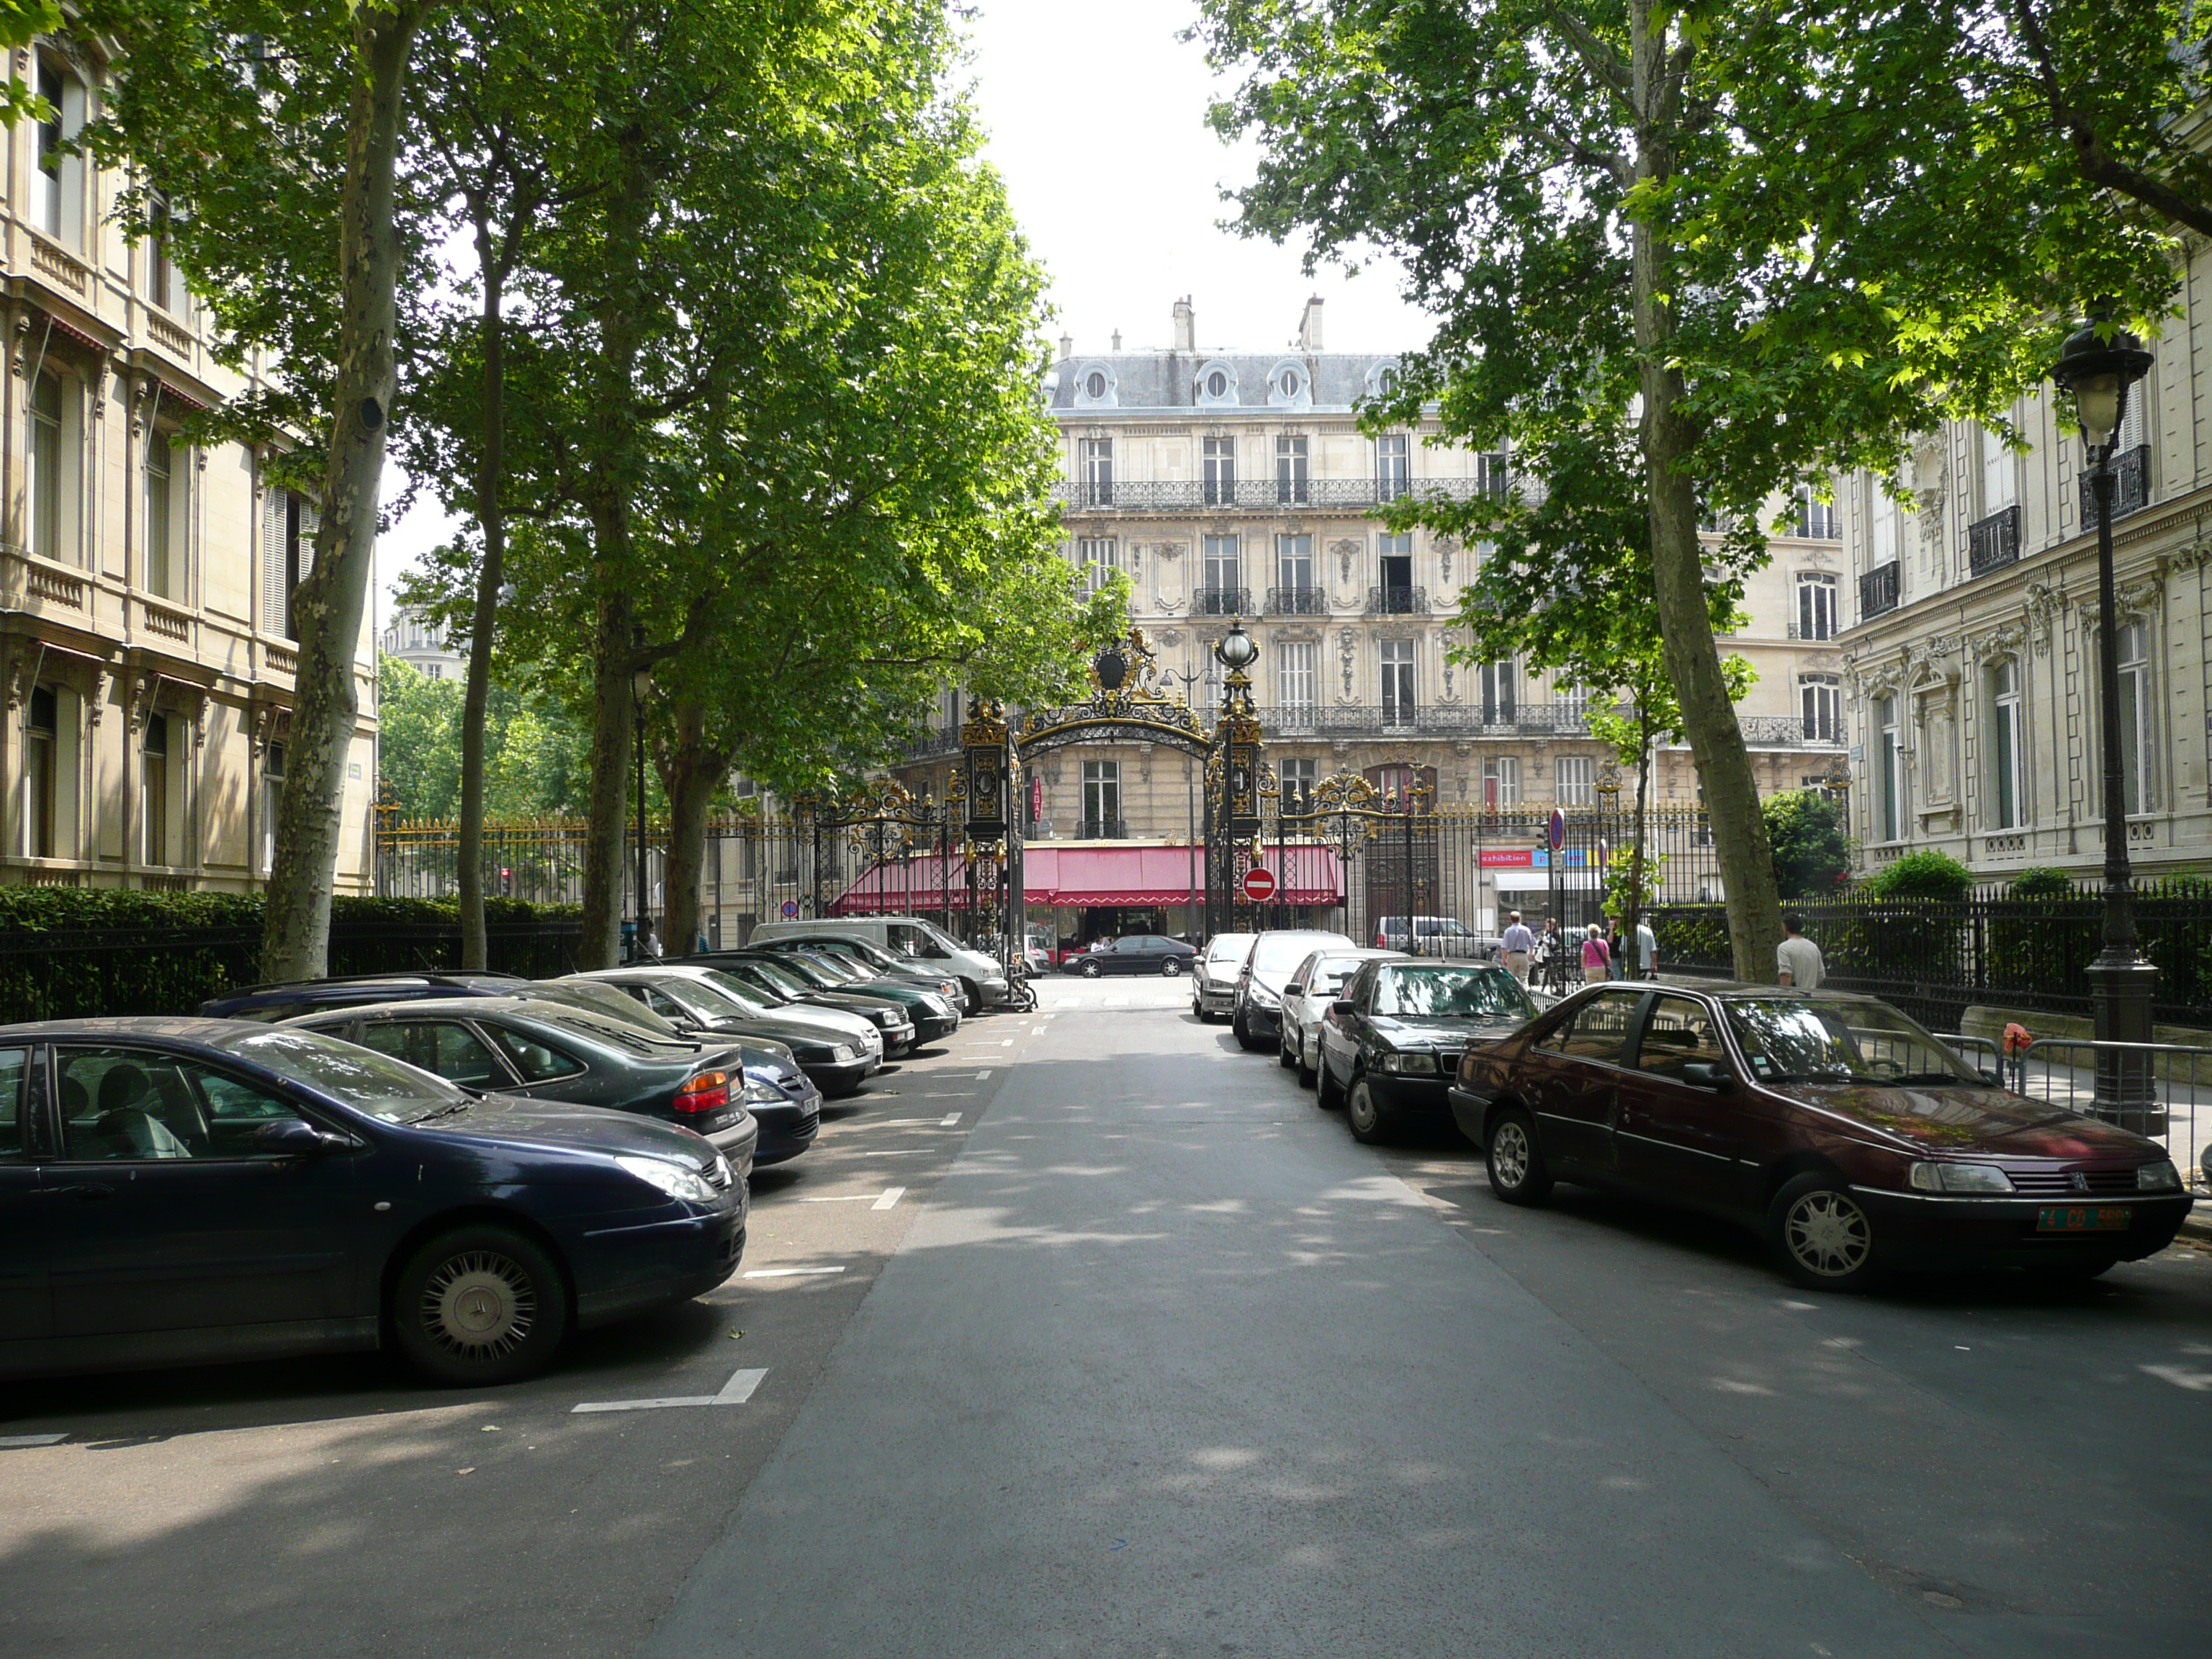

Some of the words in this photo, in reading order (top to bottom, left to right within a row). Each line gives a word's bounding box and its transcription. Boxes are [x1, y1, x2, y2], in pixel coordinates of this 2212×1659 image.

[2047, 1210, 2056, 1227] 4
[2067, 1210, 2087, 1228] CD
[2095, 1210, 2125, 1227] 560
